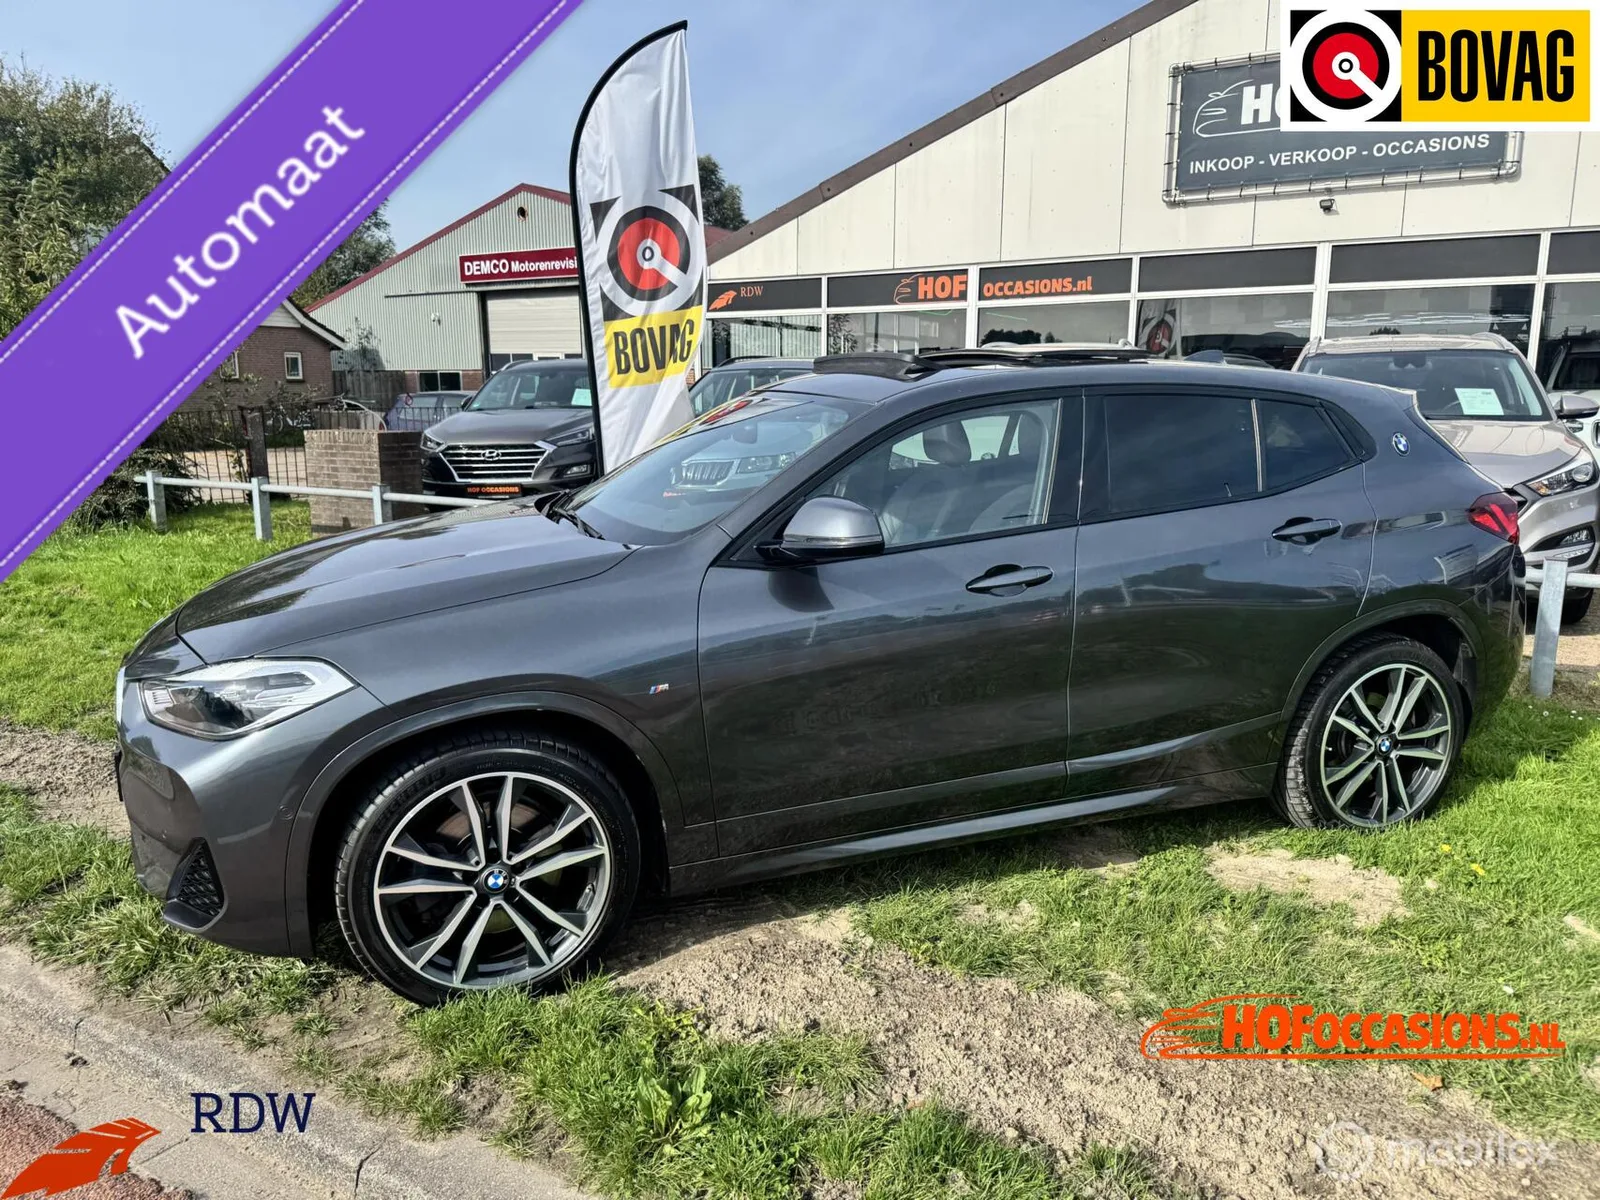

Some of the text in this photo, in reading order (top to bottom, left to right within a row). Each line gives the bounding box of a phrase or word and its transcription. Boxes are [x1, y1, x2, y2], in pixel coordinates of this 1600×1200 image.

[1189, 155, 1254, 175] INKOOP
[1268, 145, 1357, 168] VERKOOP
[1372, 133, 1491, 158] OCCASIONS
[464, 258, 509, 276] DEMCO
[740, 285, 764, 298] RDW
[917, 274, 1093, 300] HOF OCCASIONS.nl
[613, 318, 695, 376] BOVAG
